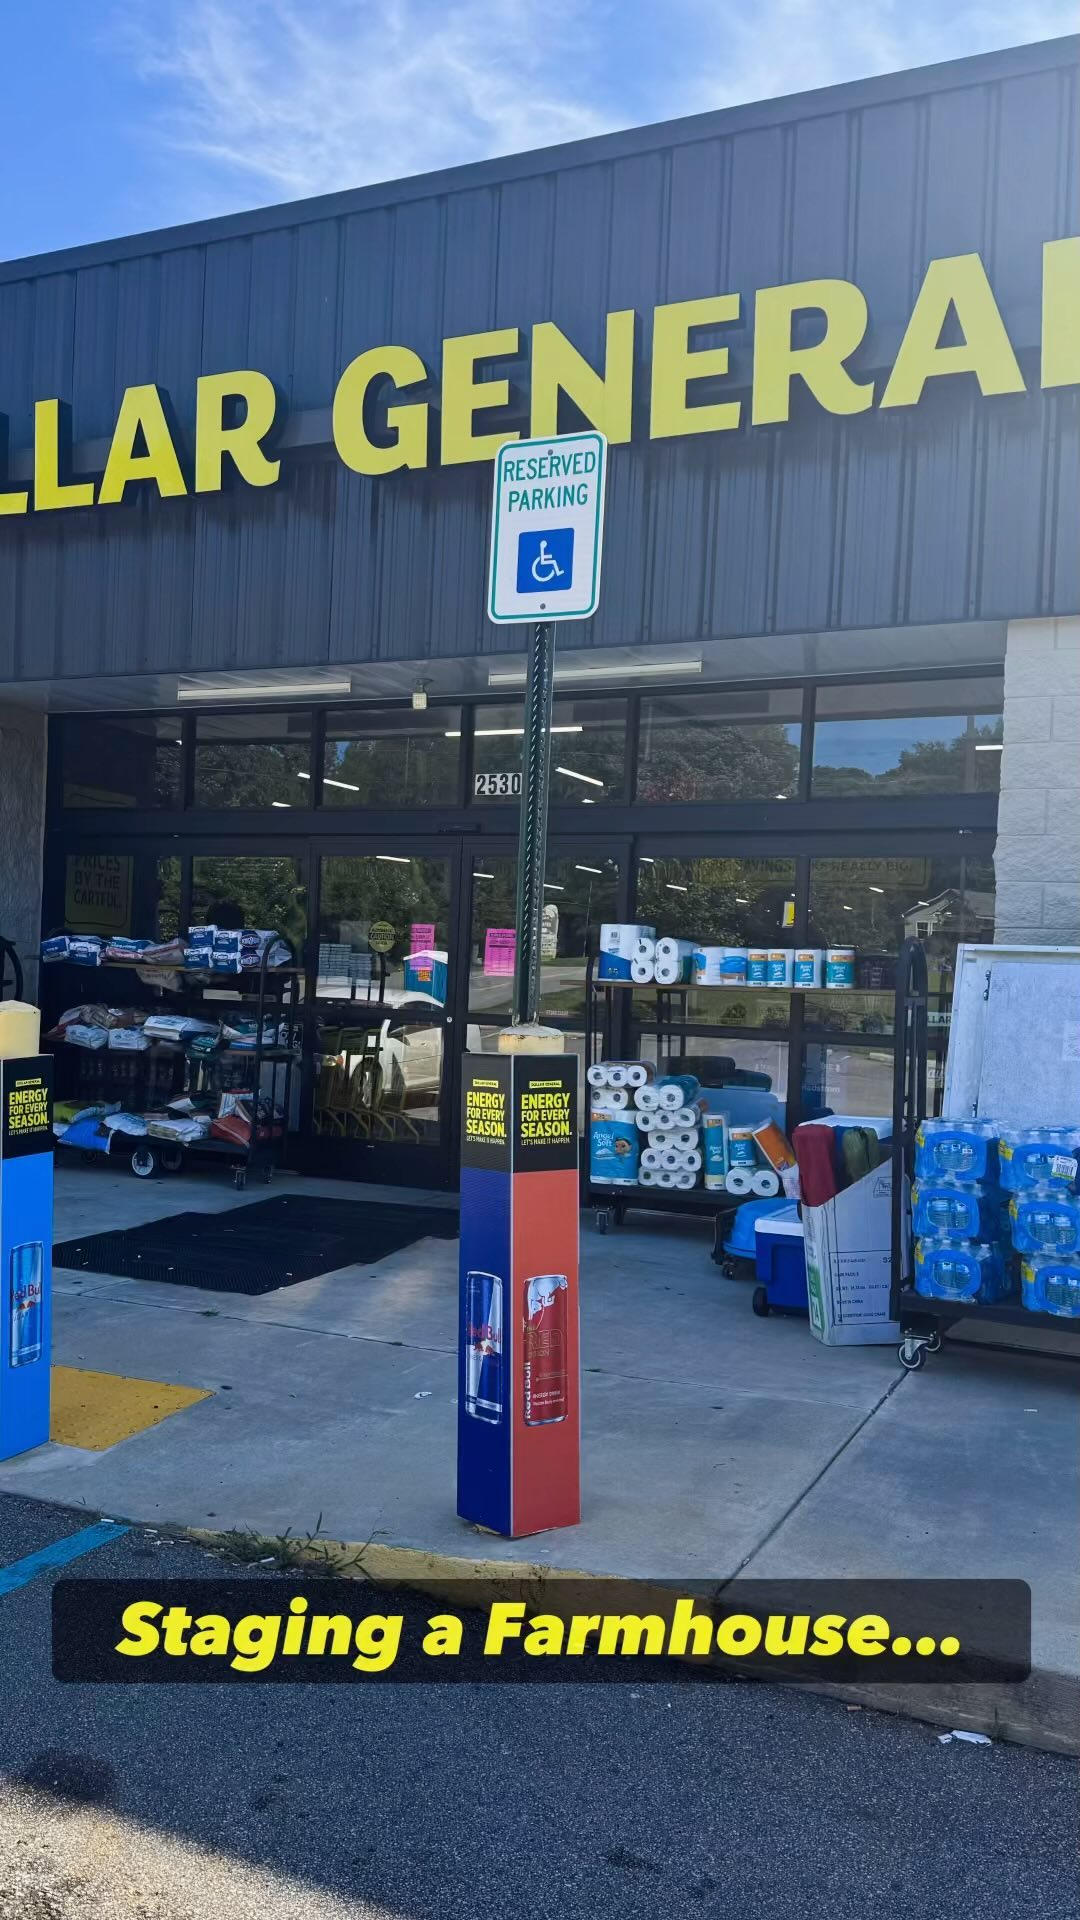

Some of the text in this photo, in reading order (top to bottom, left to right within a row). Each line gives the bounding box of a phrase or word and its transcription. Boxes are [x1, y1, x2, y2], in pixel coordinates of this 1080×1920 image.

[503, 451, 596, 482] RESERVED
[508, 483, 588, 512] PARKING
[477, 774, 521, 795] 2530
[9, 1088, 48, 1105] ENERGY
[466, 1091, 505, 1109] ENERGY
[521, 1093, 571, 1109] ENERGY
[9, 1101, 47, 1115] FOR EVERY
[466, 1106, 505, 1121] FOR EVERY
[521, 1108, 570, 1122] FOR EVERY
[9, 1112, 50, 1129] SEASON.
[466, 1119, 507, 1138] SEASON.
[521, 1121, 573, 1138] SEASON.
[594, 1131, 614, 1145] Angel
[597, 1138, 613, 1148] Soft
